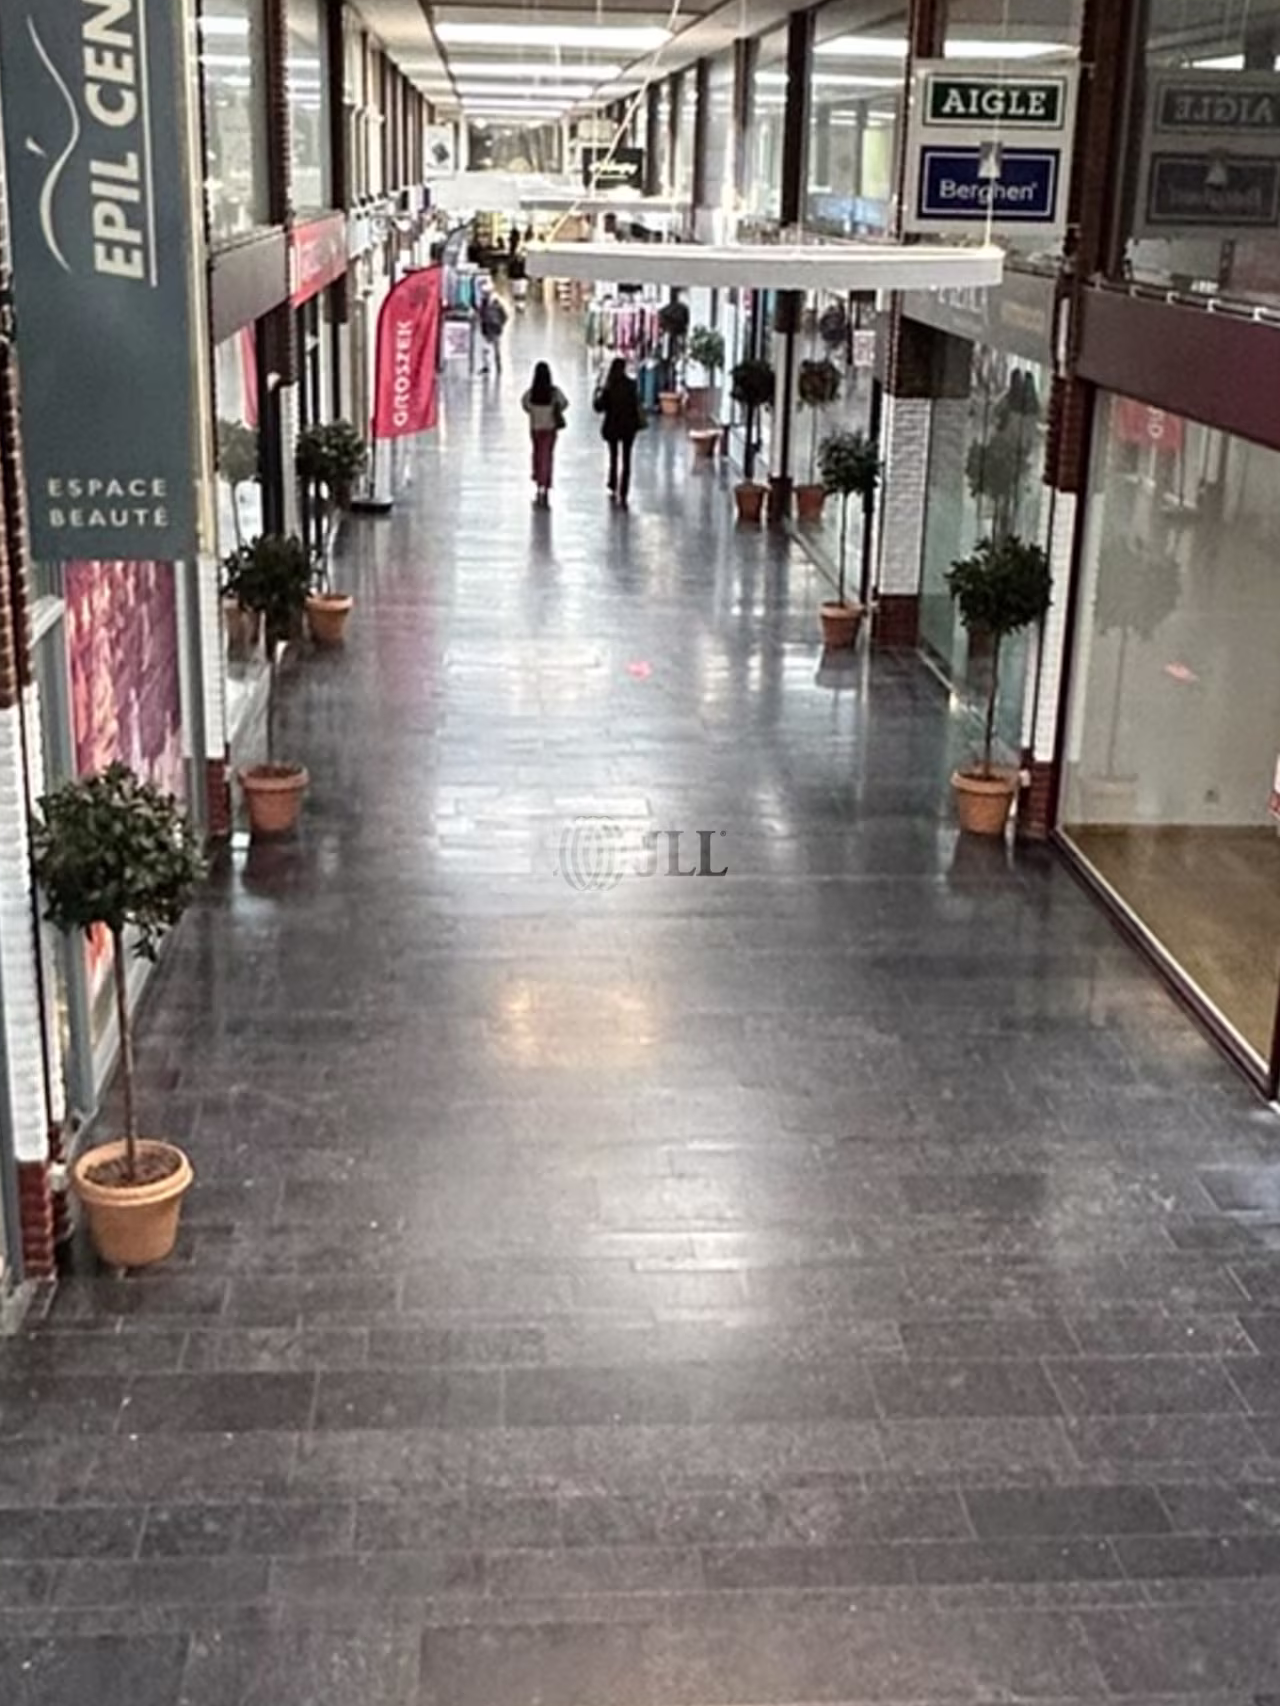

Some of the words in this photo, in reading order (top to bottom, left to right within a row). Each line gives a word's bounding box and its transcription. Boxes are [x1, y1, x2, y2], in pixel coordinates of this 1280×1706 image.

[941, 89, 1048, 116] AIGLE
[91, 151, 144, 281] EPIL
[393, 320, 413, 428] GROSZEK
[48, 479, 168, 499] ESPACE
[49, 505, 170, 528] BEAUTÉ
